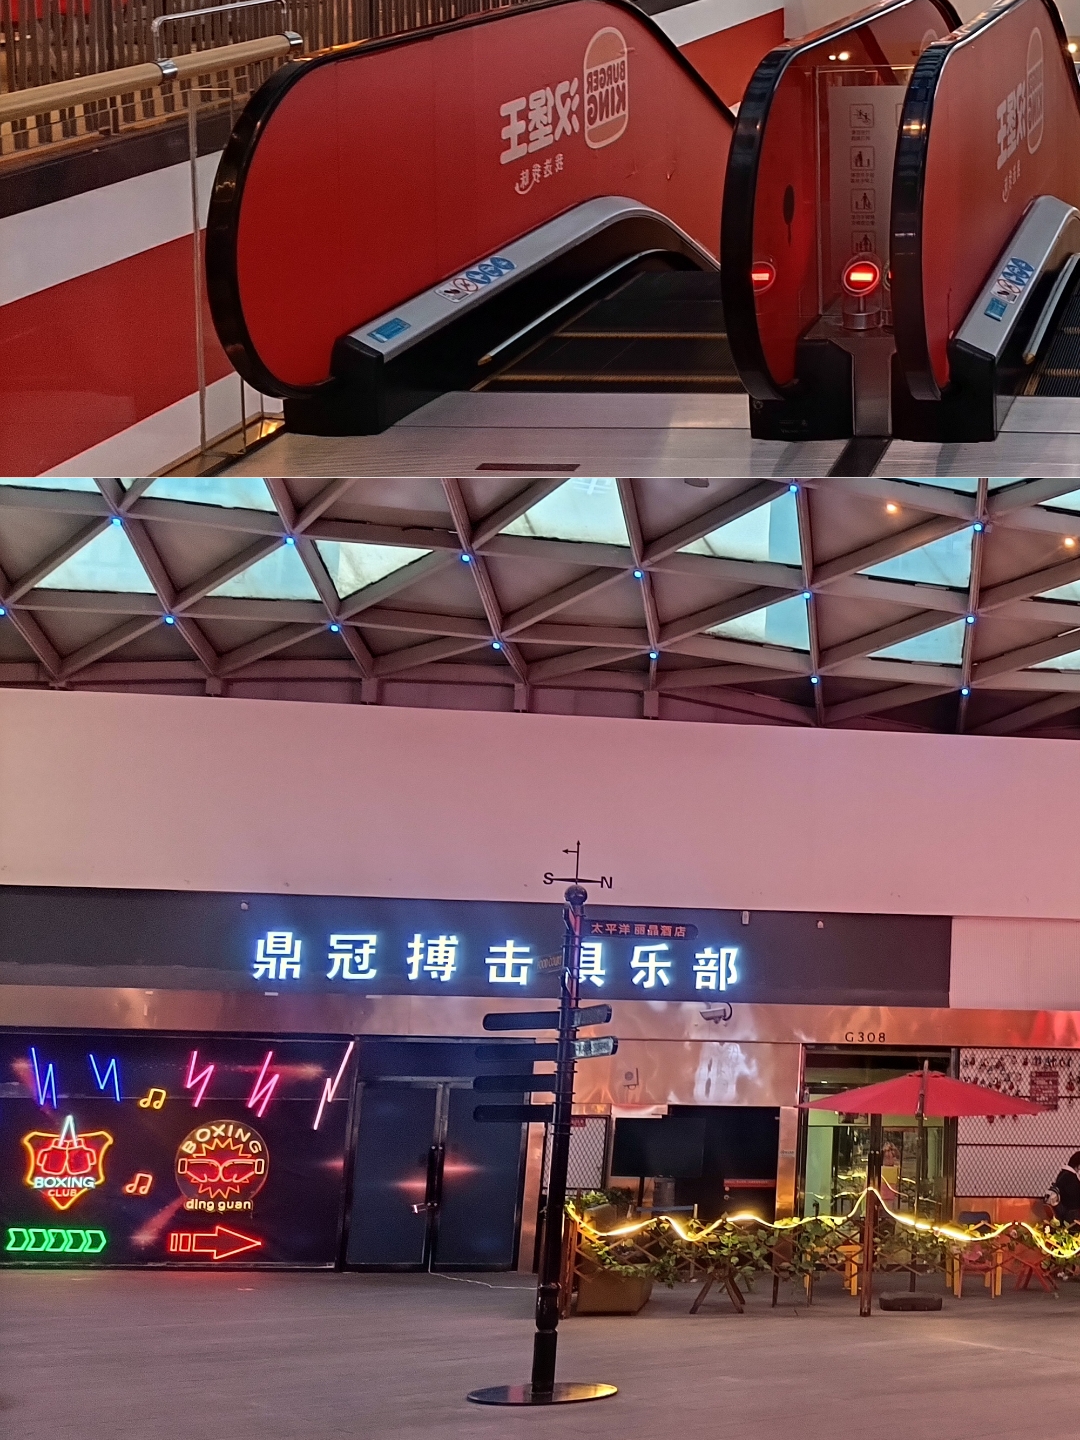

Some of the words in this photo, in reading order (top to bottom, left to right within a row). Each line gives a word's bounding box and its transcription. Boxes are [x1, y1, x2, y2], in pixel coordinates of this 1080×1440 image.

[543, 871, 554, 885] S
[600, 876, 613, 889] N
[253, 930, 740, 992] 鼎冠搏击俱乐部
[844, 1031, 886, 1043] G308
[181, 1123, 263, 1155] BOXING
[33, 1176, 96, 1190] BOXING
[47, 1188, 78, 1198] CLUB
[186, 1199, 214, 1212] ding
[218, 1200, 252, 1212] guan
